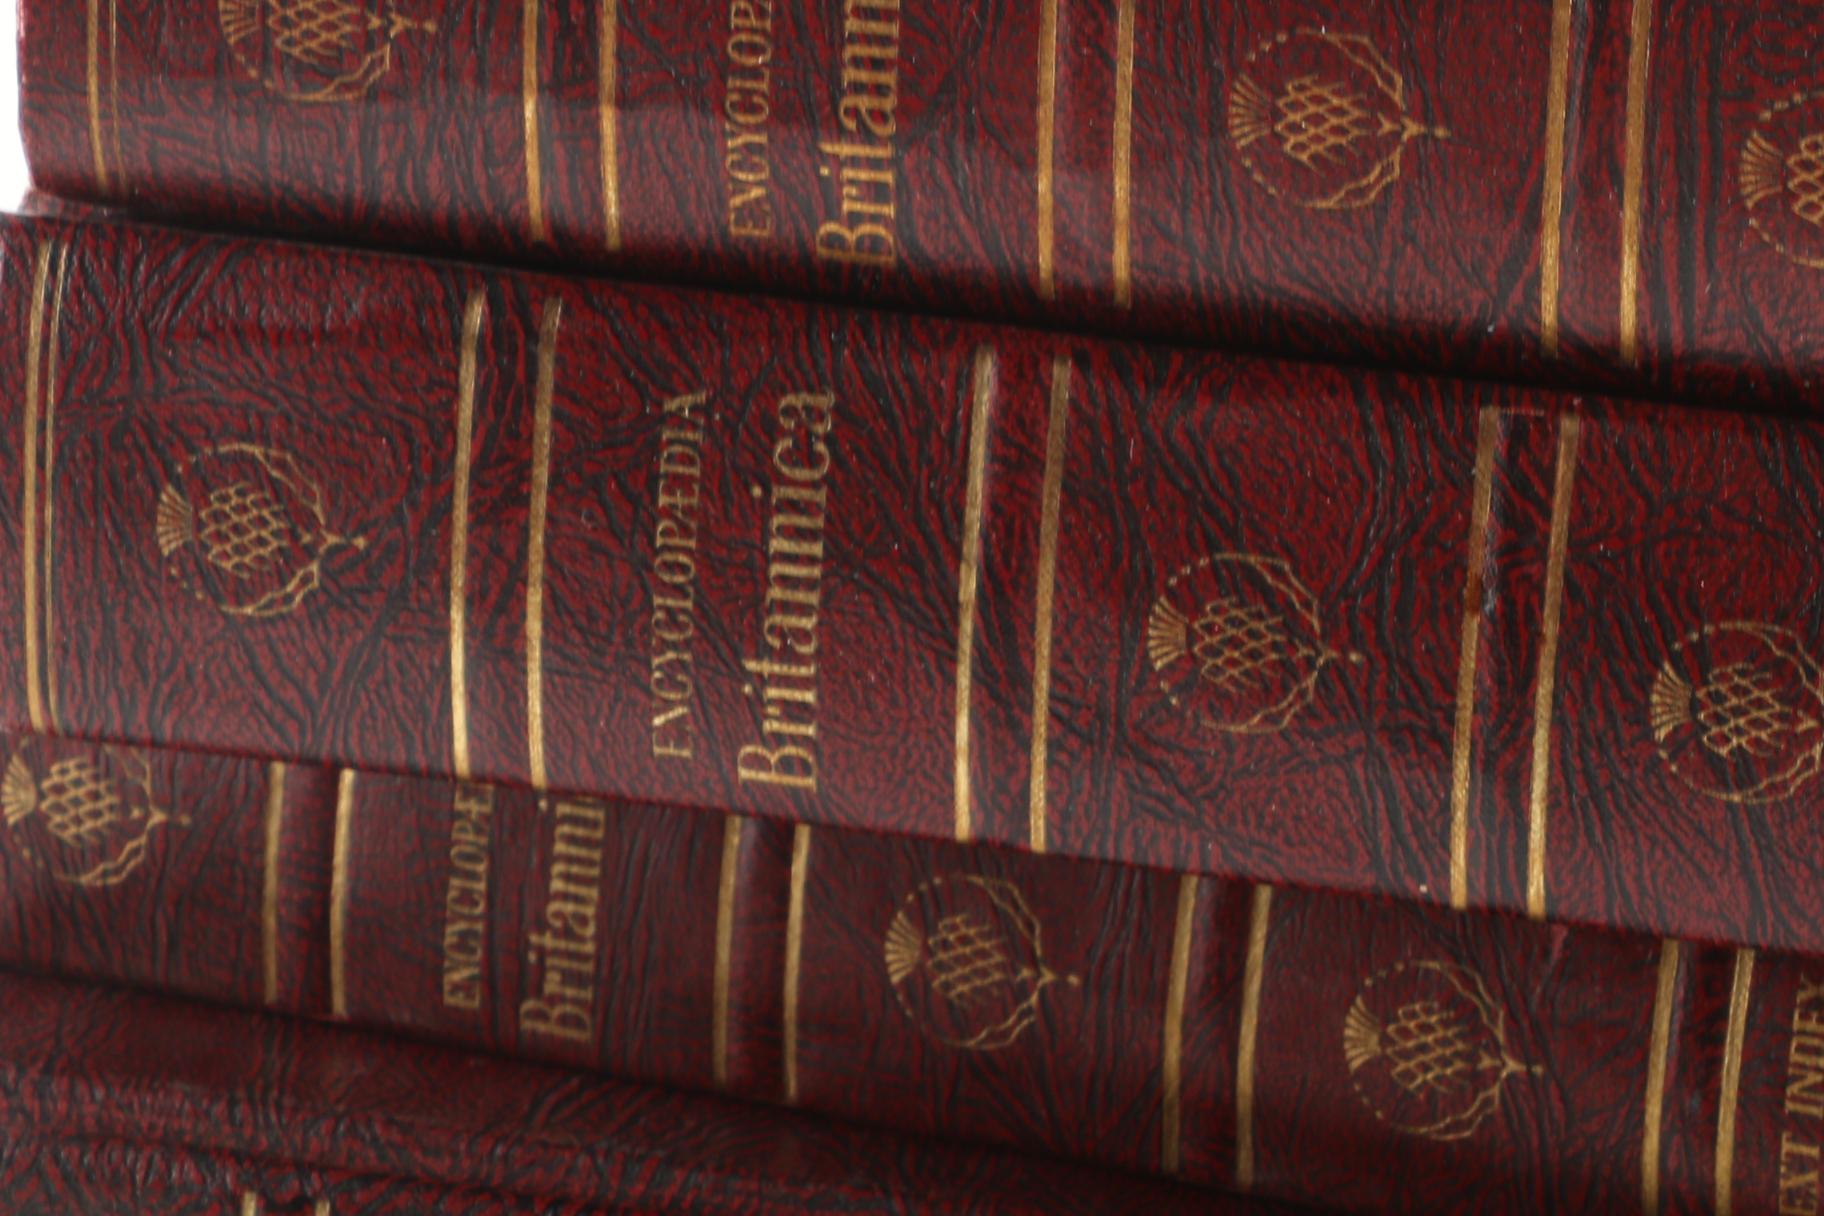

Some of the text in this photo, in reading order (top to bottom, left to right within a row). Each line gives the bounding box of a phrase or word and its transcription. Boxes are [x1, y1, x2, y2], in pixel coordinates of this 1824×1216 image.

[737, 390, 835, 793] Britannica
[443, 784, 494, 1009] ENCYCLOPÆ
[519, 795, 605, 1043] Britanni
[1779, 1131, 1820, 1216] EXT
